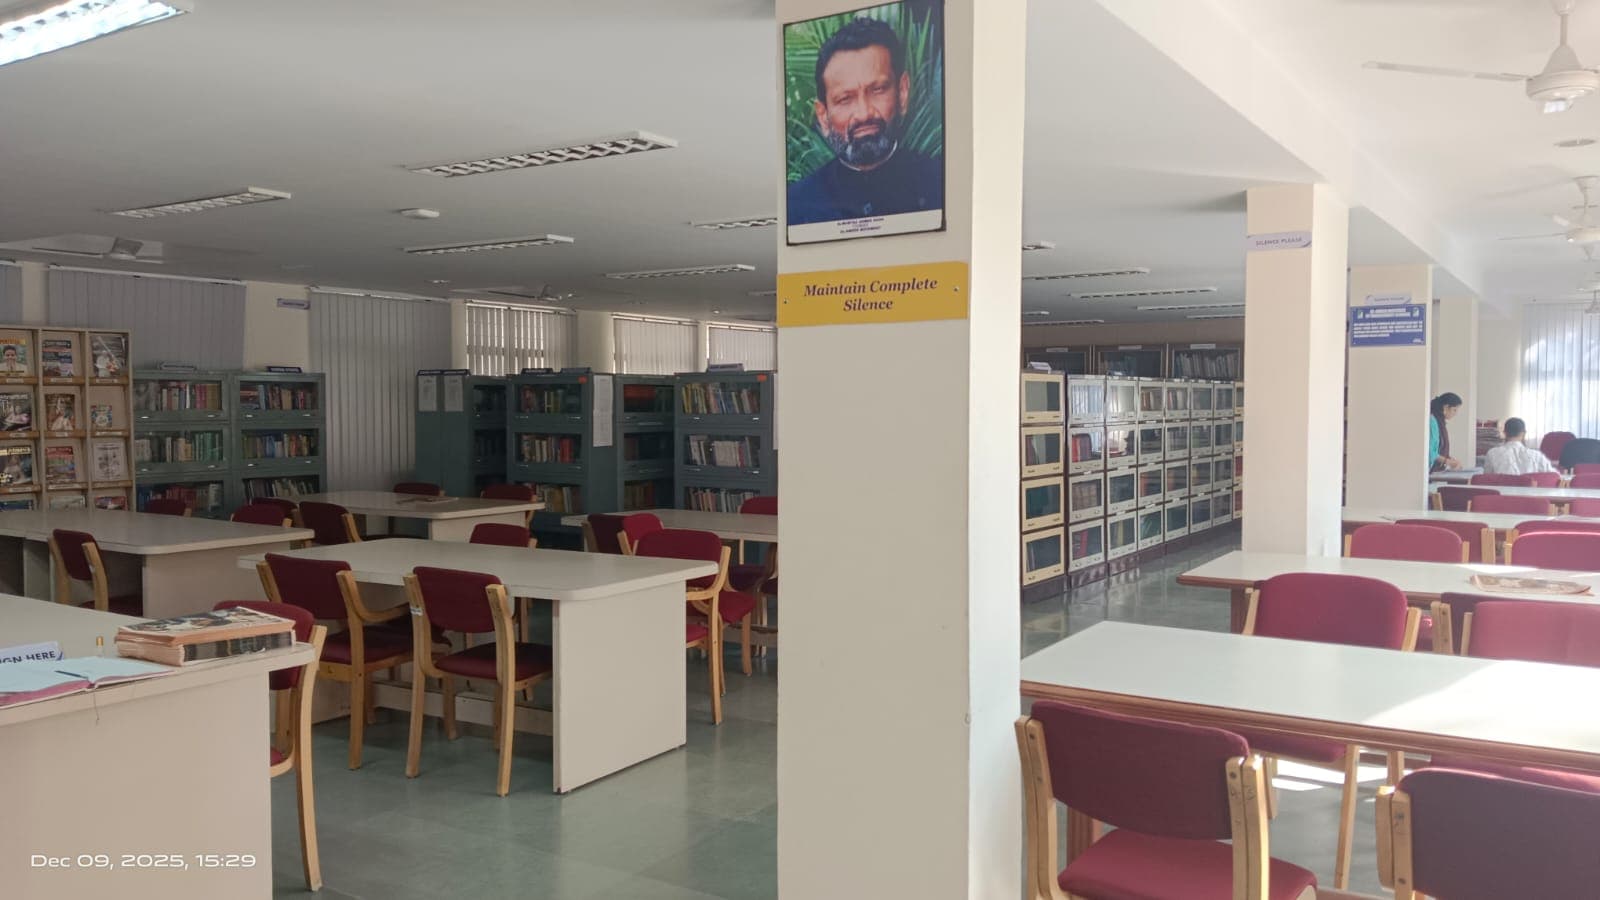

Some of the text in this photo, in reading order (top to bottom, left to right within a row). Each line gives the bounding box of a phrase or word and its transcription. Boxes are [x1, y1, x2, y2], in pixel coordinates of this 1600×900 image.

[804, 277, 938, 297] Maintain Complete
[843, 298, 894, 312] Silence
[26, 650, 56, 661] HERE
